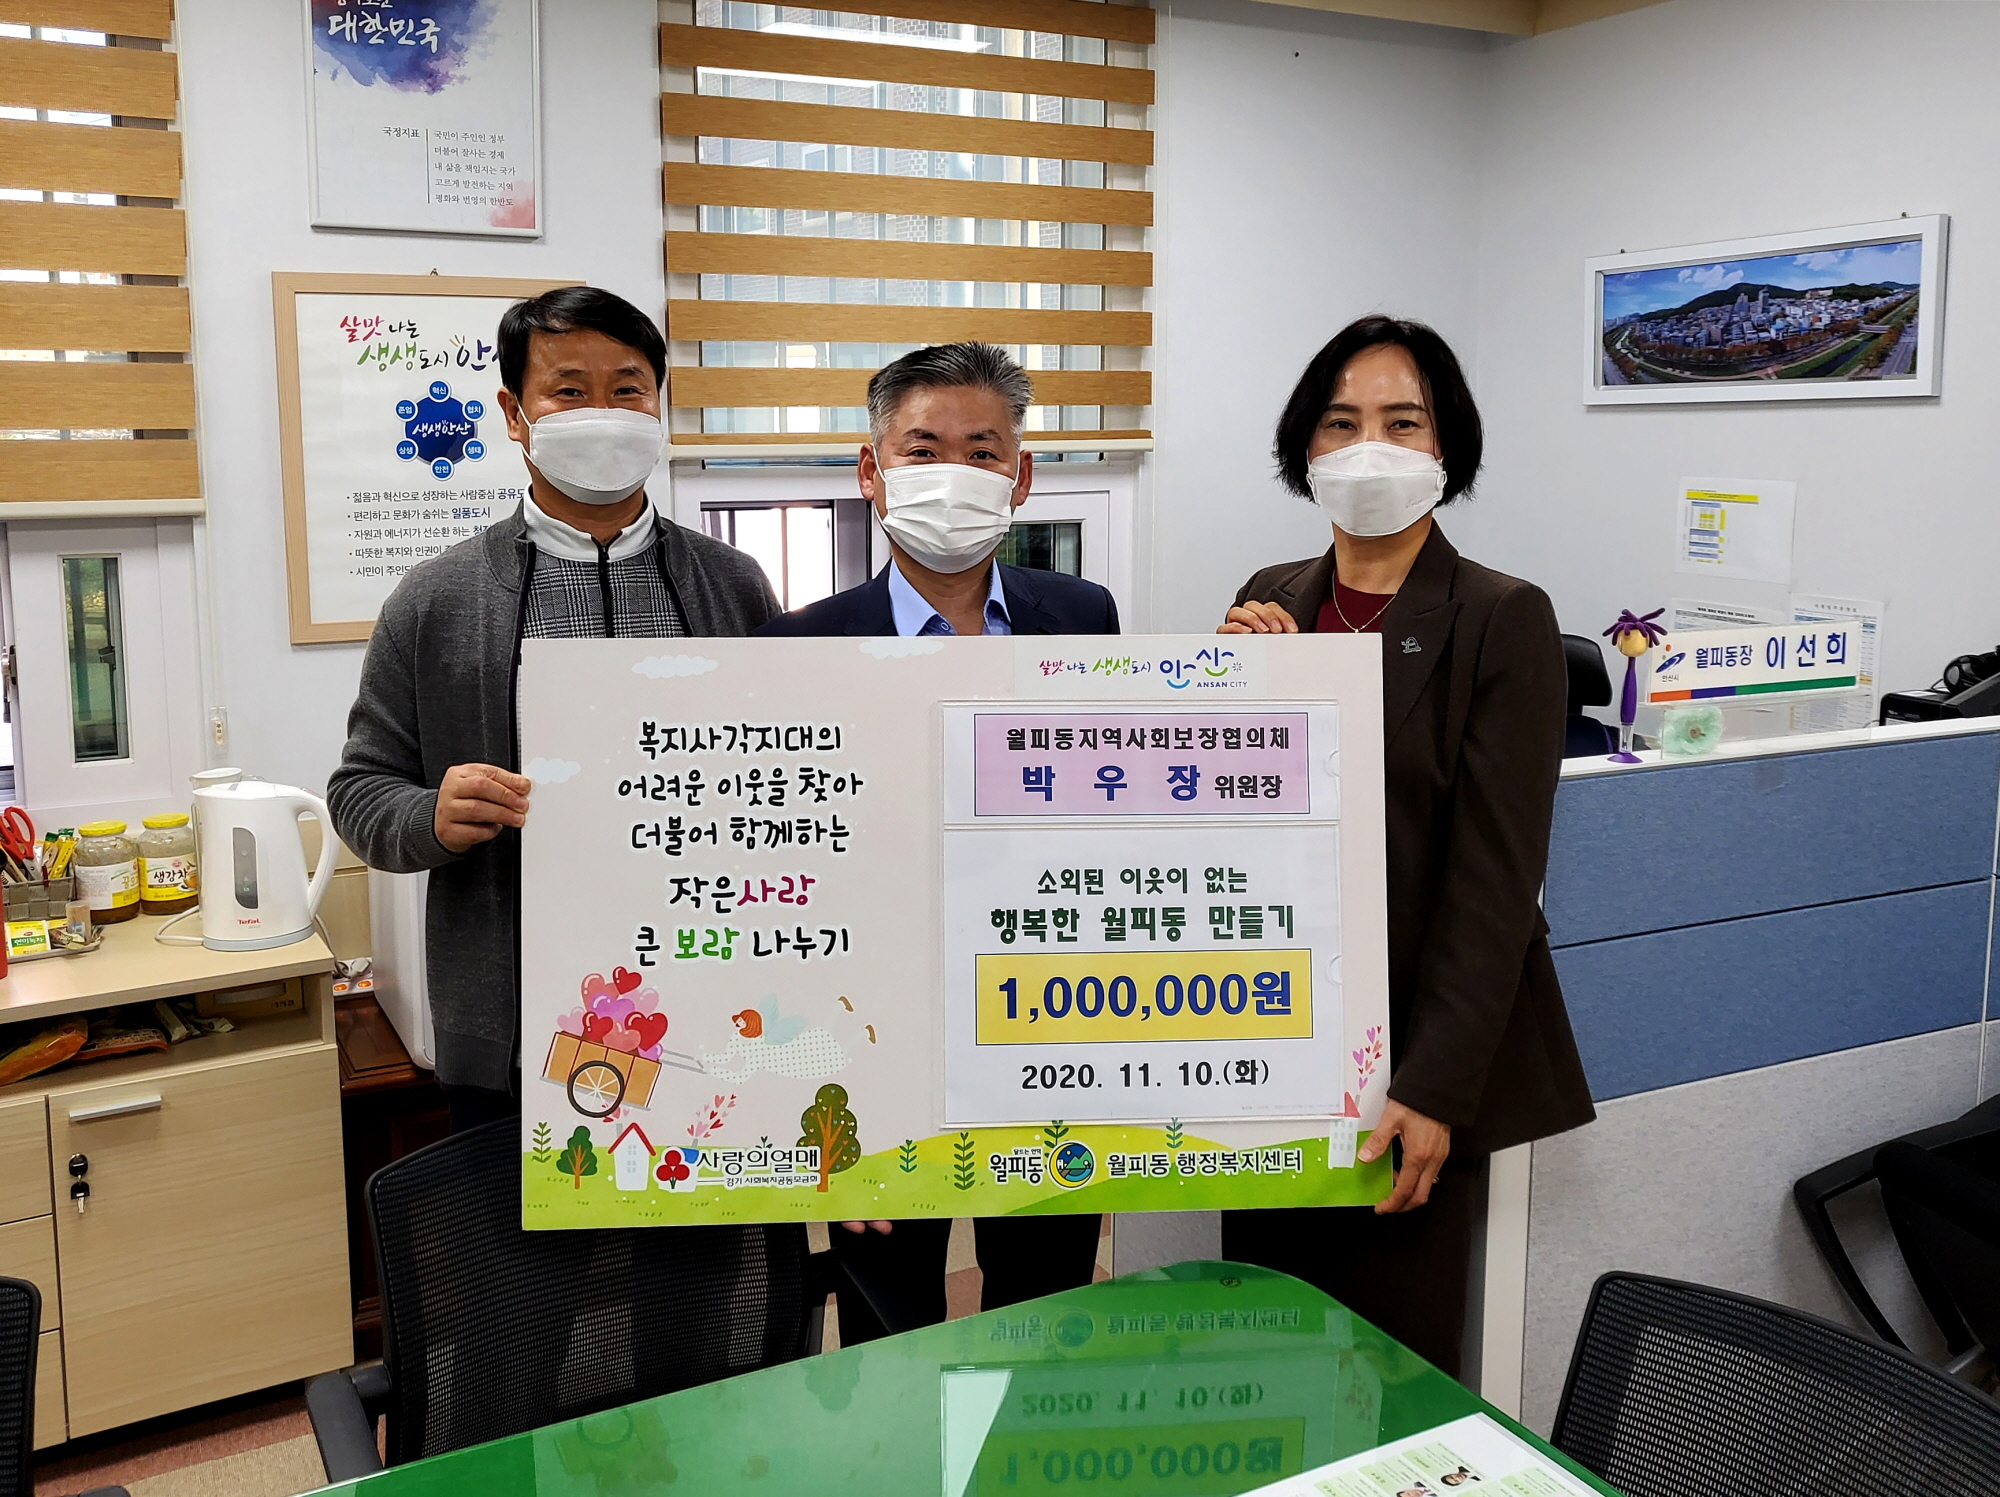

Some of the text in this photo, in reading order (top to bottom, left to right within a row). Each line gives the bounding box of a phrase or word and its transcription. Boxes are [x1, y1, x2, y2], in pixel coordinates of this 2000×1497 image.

[328, 10, 441, 54] 대한민국
[382, 126, 420, 138] 국정지표
[433, 130, 459, 141] 국민이
[489, 135, 505, 144] 정부
[434, 146, 505, 160] 더불어 잘사는 경제
[434, 162, 517, 176] 내 삶을 책임지는 국가
[435, 178, 514, 192] 고르게 발전하는 지역
[435, 193, 514, 207] 평화와 번영의 한반도
[339, 315, 420, 343] 살맛 나는
[456, 338, 500, 372] 안
[432, 386, 447, 395] 혁신
[399, 446, 414, 455] 상생
[434, 466, 449, 474] 안전
[352, 491, 381, 503] 젊음과
[383, 491, 421, 502] 혁신으로
[421, 490, 458, 501] 성장하는
[459, 489, 495, 500] 사람중심
[353, 506, 491, 522] 편리하고 문화가 숨쉬는 일품도시
[354, 530, 382, 540] 자원과
[384, 528, 421, 540] 에너지가
[423, 527, 450, 538] 선순환
[452, 526, 471, 537] 하는
[355, 548, 383, 559] 따뜻한
[385, 547, 413, 558] 복지와
[415, 545, 442, 557] 인권이
[356, 566, 384, 577] 시민이
[1695, 645, 1753, 669] 월피동장
[1038, 659, 1065, 677] 살맛
[1066, 661, 1088, 674] 나는
[1662, 674, 1680, 682] 안산시
[638, 721, 842, 760] 복지사각지대의
[1005, 726, 1290, 752] 월피동지역사회보장협의체
[618, 767, 864, 807] 어려운 이웃을 찾아
[1214, 774, 1283, 800] 위원장
[631, 815, 850, 857] 더불어 함께하는
[154, 868, 188, 883] 생강차
[1037, 866, 1248, 896] 소외된 이웃이 없는
[989, 905, 1294, 944] 행복한 월피동 만들기
[635, 926, 850, 967] 큰 보람 나누기
[998, 970, 1292, 1023] 1,000,000원
[1021, 1058, 1270, 1090] 2020. 11. 10.(화)
[696, 1149, 818, 1175] 사랑의열매
[990, 1154, 1043, 1184] 월피동
[1107, 1148, 1303, 1177] 월피동 행정복지센터
[726, 1175, 818, 1187] 경기 사회복지공동모금회
